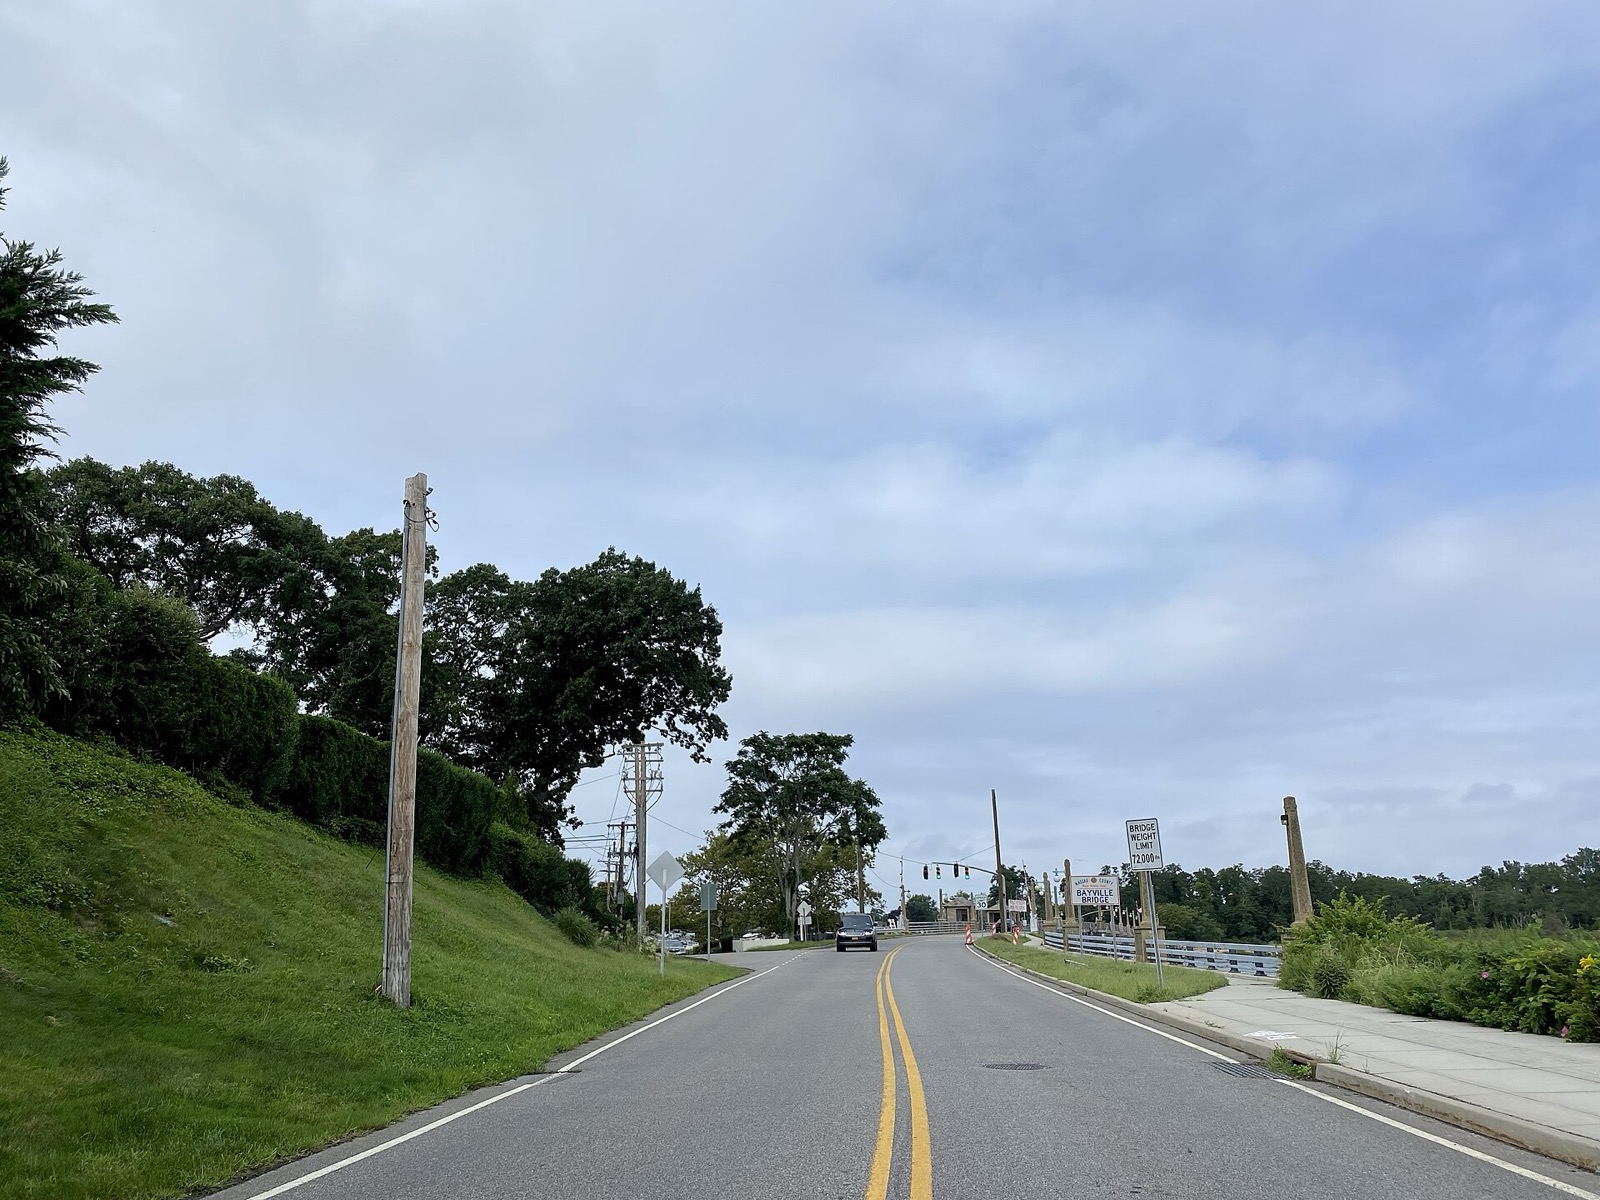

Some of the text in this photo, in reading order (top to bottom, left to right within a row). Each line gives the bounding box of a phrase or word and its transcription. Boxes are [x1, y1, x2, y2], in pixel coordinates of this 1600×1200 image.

[1130, 824, 1156, 832] BRIDGE
[1130, 832, 1156, 841] WEIGHT
[1136, 842, 1153, 850] LIMIT
[1132, 853, 1154, 864] 72,000
